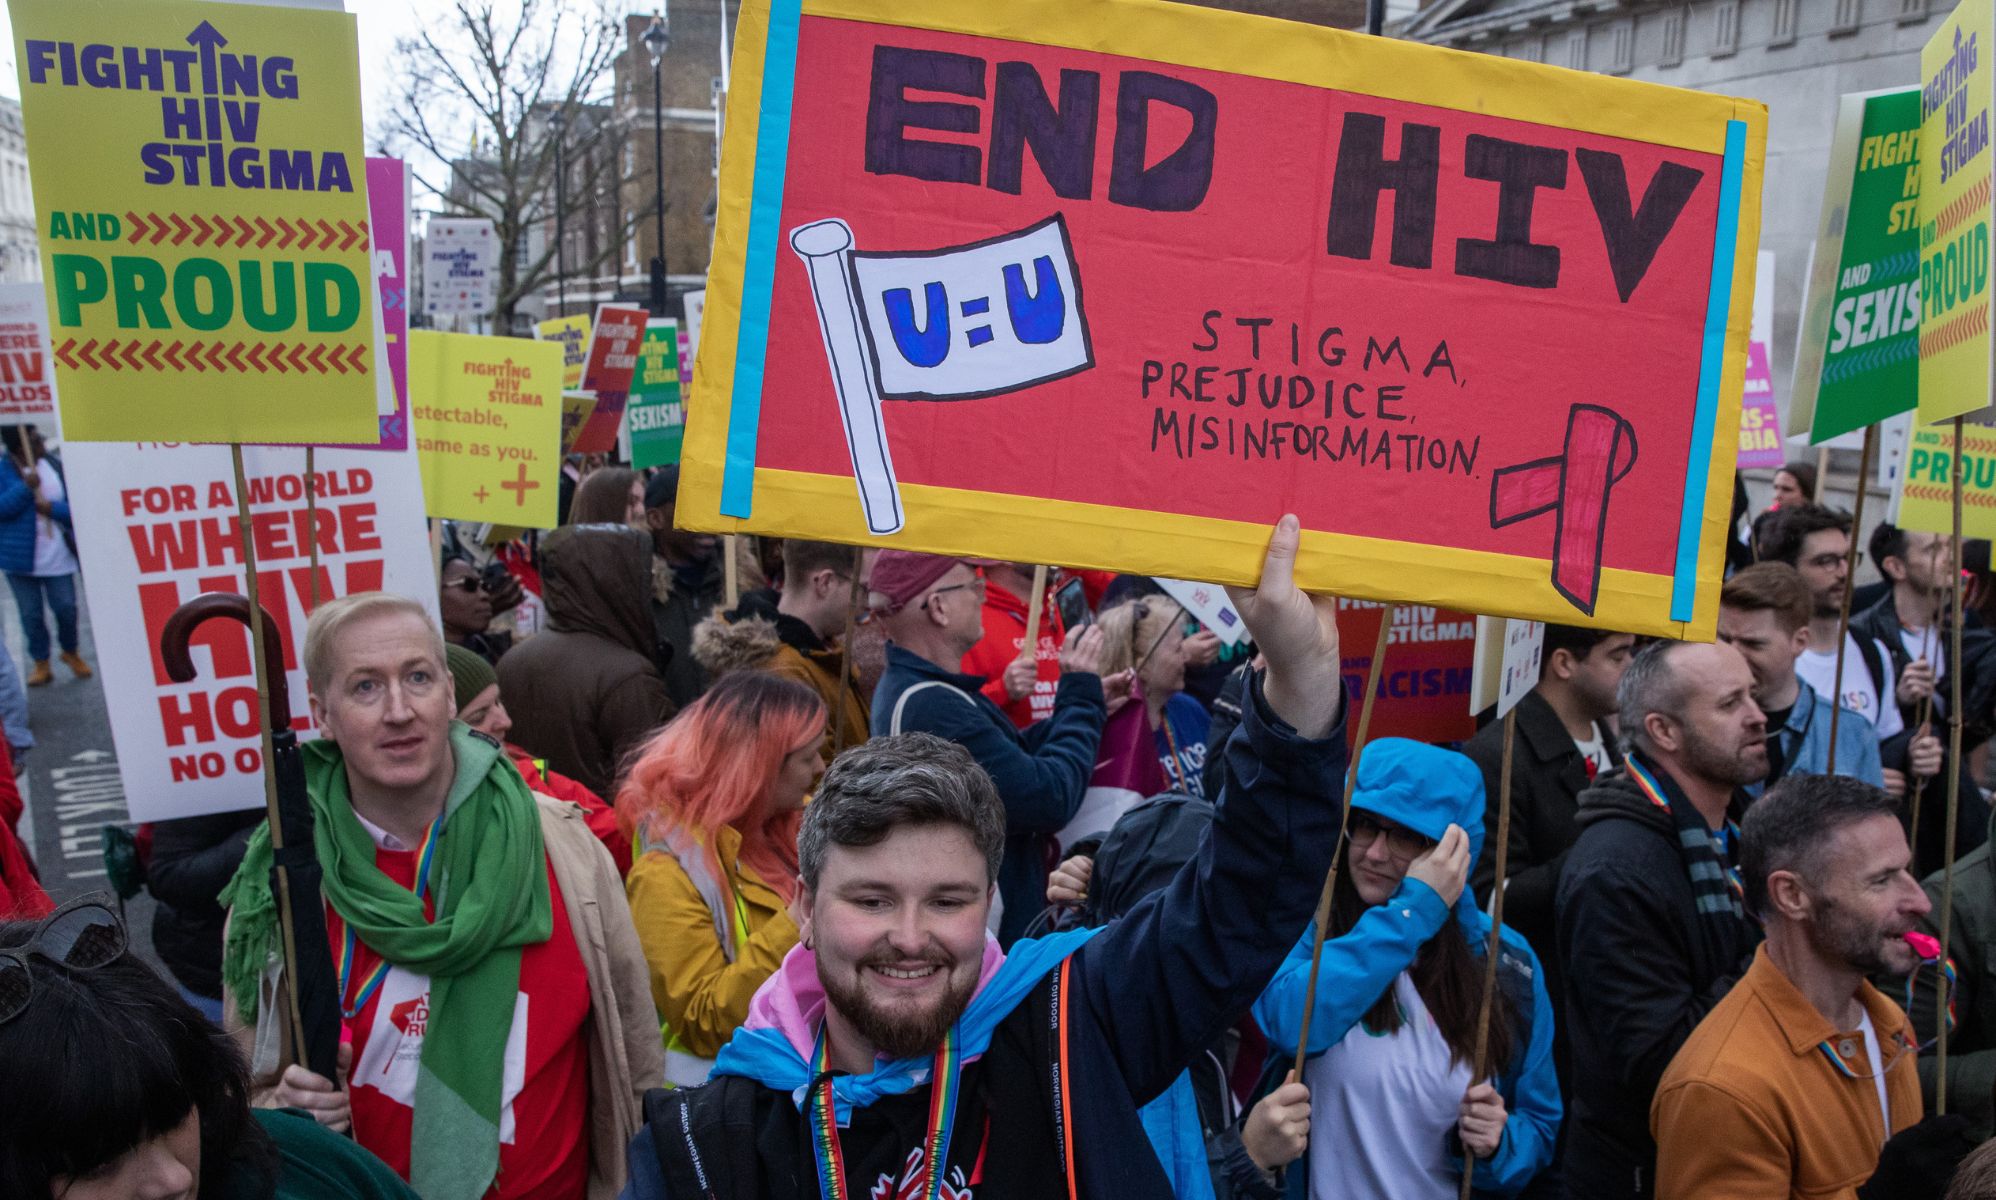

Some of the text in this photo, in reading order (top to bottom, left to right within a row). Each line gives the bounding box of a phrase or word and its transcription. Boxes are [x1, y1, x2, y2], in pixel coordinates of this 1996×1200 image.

[25, 28, 299, 99] FIGHTING
[1922, 29, 1977, 124] FIGHTING
[162, 97, 260, 143] HIV
[1946, 83, 1968, 138] HIV
[140, 142, 354, 193] STIGMA
[865, 44, 1704, 303] END HIV
[1940, 108, 1989, 185] STIGMA
[50, 211, 121, 241] AND
[52, 253, 361, 333] PROUD
[1840, 263, 1871, 291] AND
[1921, 220, 1989, 324] PROUD
[882, 255, 1066, 368] U=U
[464, 360, 532, 379] FIGHTING
[1192, 310, 1466, 388] STIGMA,
[488, 390, 543, 407] STIGMA
[495, 377, 521, 392] HIV
[1142, 360, 1416, 424] PREJUDICE,
[629, 402, 682, 431] SEXISM
[1151, 407, 1480, 479] MISINFORMATION.
[416, 438, 539, 462] same as you.
[121, 468, 374, 517] FOR A WORLD
[127, 503, 382, 574] WHERE
[1387, 621, 1475, 645] STIGMA
[1393, 605, 1437, 625] HIV
[170, 752, 225, 783] NO
[1050, 984, 1059, 1029] OUTDOOR
[1052, 1062, 1063, 1123] NORWEGIAN
[685, 1133, 709, 1191] NORWEGIAN
[924, 1129, 946, 1196] FOUNDATION
